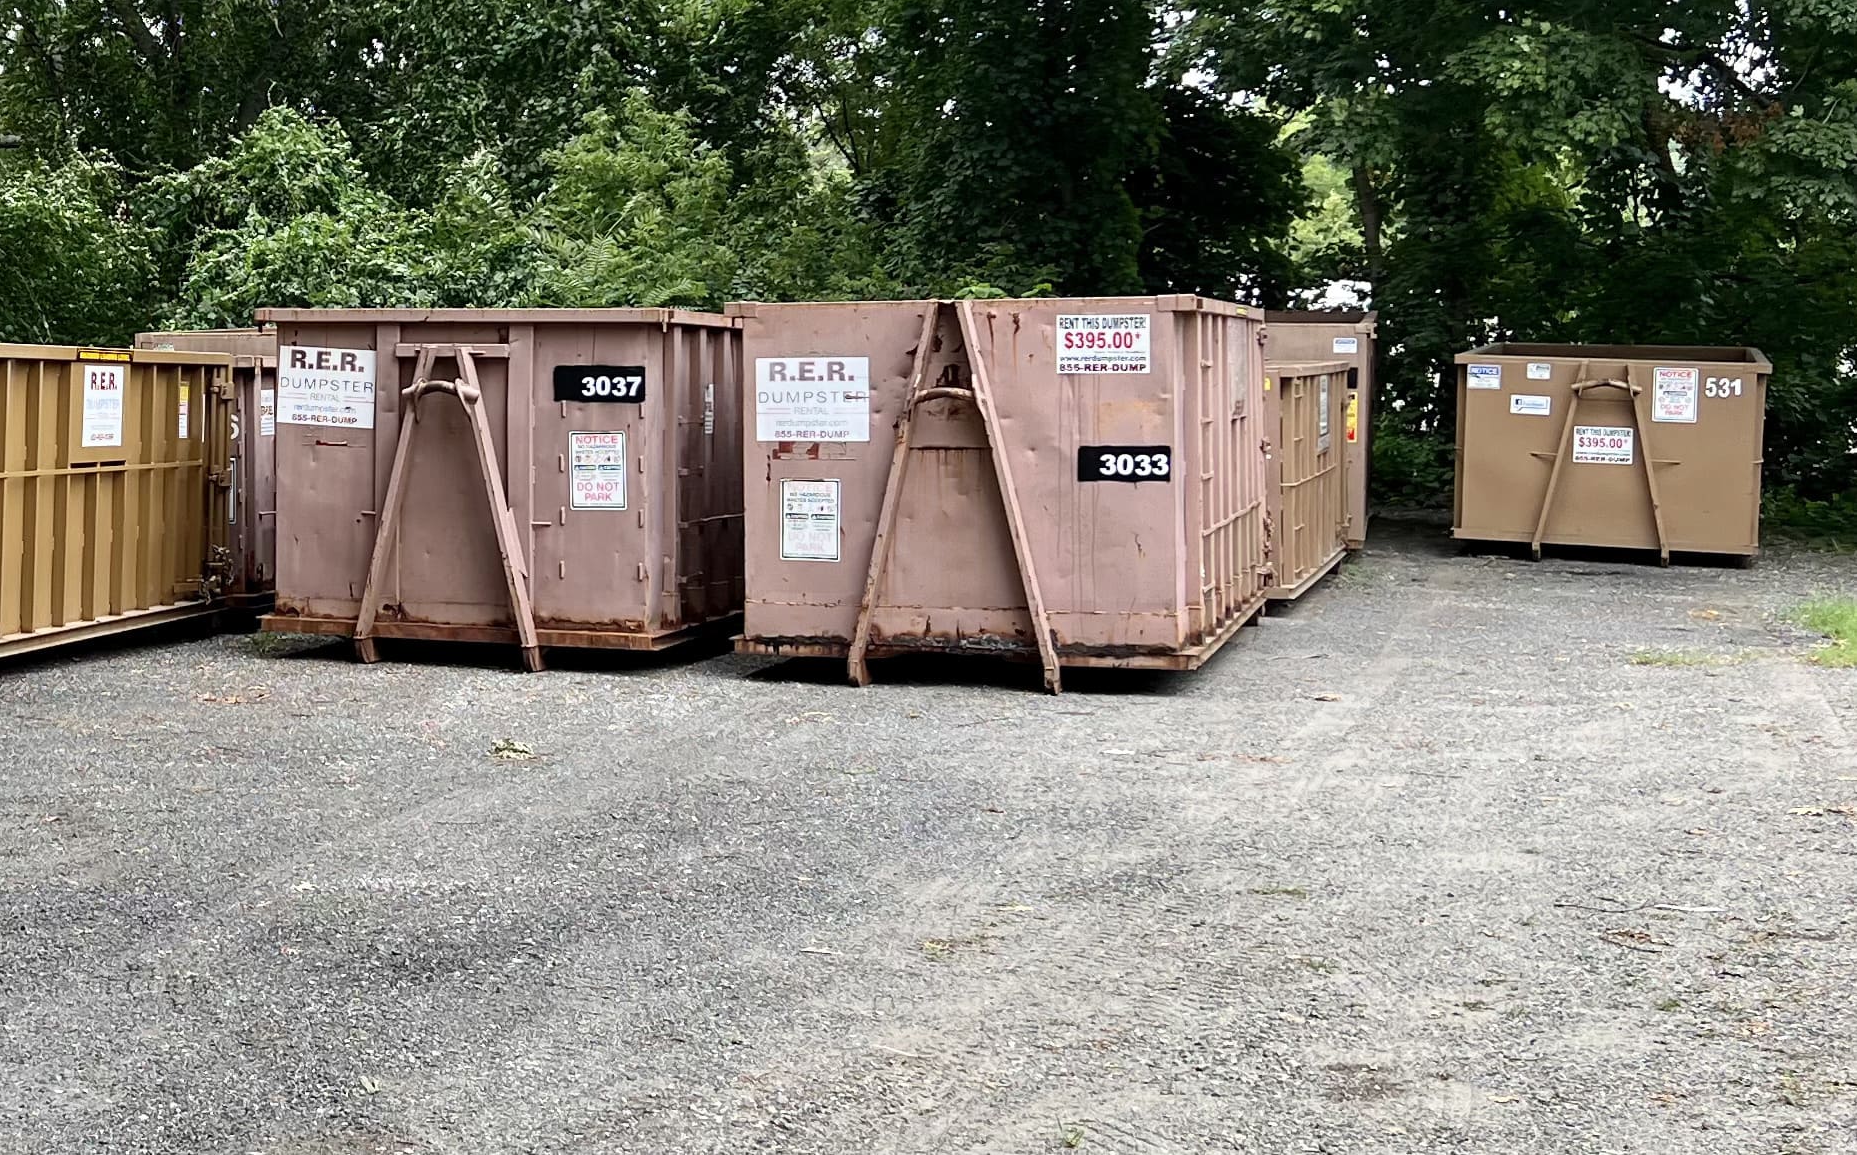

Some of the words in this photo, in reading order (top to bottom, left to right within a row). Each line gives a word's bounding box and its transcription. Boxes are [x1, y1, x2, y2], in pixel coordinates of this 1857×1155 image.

[1059, 317, 1079, 329] RENT
[1082, 317, 1100, 329] THIS
[290, 349, 365, 373] R.E.R.
[1059, 355, 1146, 363] www.rerdumpster.com
[769, 361, 855, 382] R.E.R.
[1059, 363, 1146, 371] 855-RER-DUMP
[90, 371, 118, 391] R.E.R.
[281, 376, 374, 393] DUMPSTER
[582, 376, 642, 397] 3037
[1705, 377, 1742, 398] 531
[310, 392, 339, 402] RENTAL
[758, 391, 867, 404] DUMPSTER
[794, 407, 830, 415] RENTAL
[291, 413, 358, 424] 855-RER-DUMP
[575, 435, 619, 444] NOTICE
[774, 430, 850, 439] 855-RER-DUMP
[1099, 453, 1169, 476] 3033
[577, 482, 593, 492] DO
[596, 482, 620, 492] NOT
[584, 493, 612, 502] PARK
